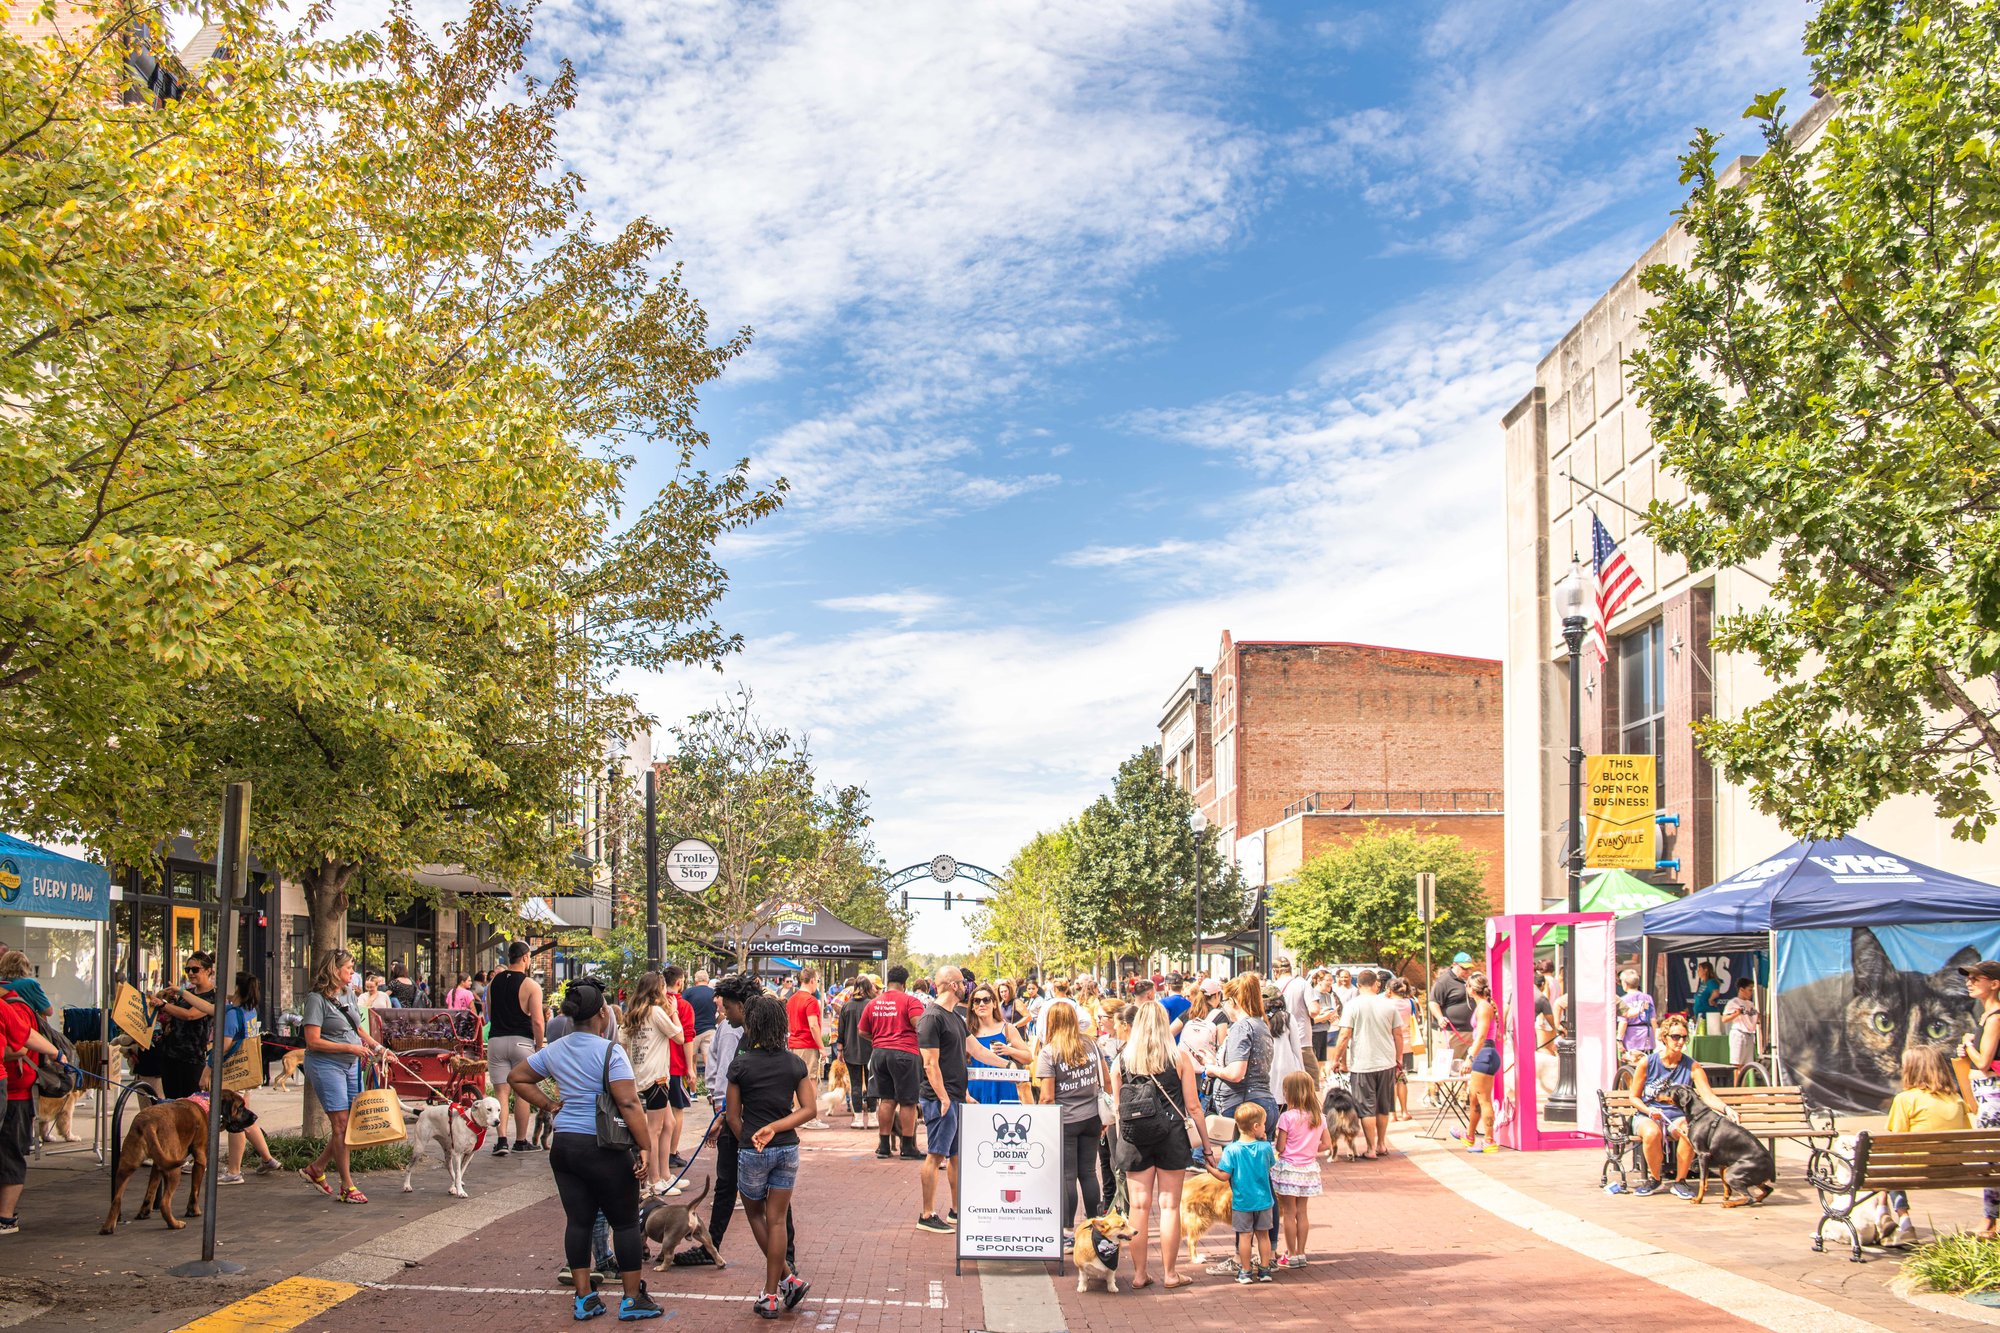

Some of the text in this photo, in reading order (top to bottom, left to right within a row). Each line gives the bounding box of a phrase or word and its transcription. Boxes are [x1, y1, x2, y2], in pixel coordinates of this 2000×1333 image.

[1609, 760, 1633, 768] THIS
[1603, 772, 1639, 781] BLOCK
[1593, 785, 1649, 794] OPEN FOR
[1593, 798, 1649, 806] BUSINESS!
[1597, 834, 1644, 850] EVANSVILLE
[673, 852, 715, 865] Trolley
[1807, 854, 1910, 874] VHS
[681, 868, 708, 879] Stop
[33, 876, 94, 902] EVERY PAW
[774, 912, 814, 922] ucker
[1059, 1082, 1079, 1091] Your
[1012, 1151, 1029, 1159] DAY
[968, 1205, 998, 1213] German
[999, 1206, 1034, 1214] American
[966, 1235, 1055, 1243] PRESENTING
[976, 1244, 1044, 1252] SPONSOR
